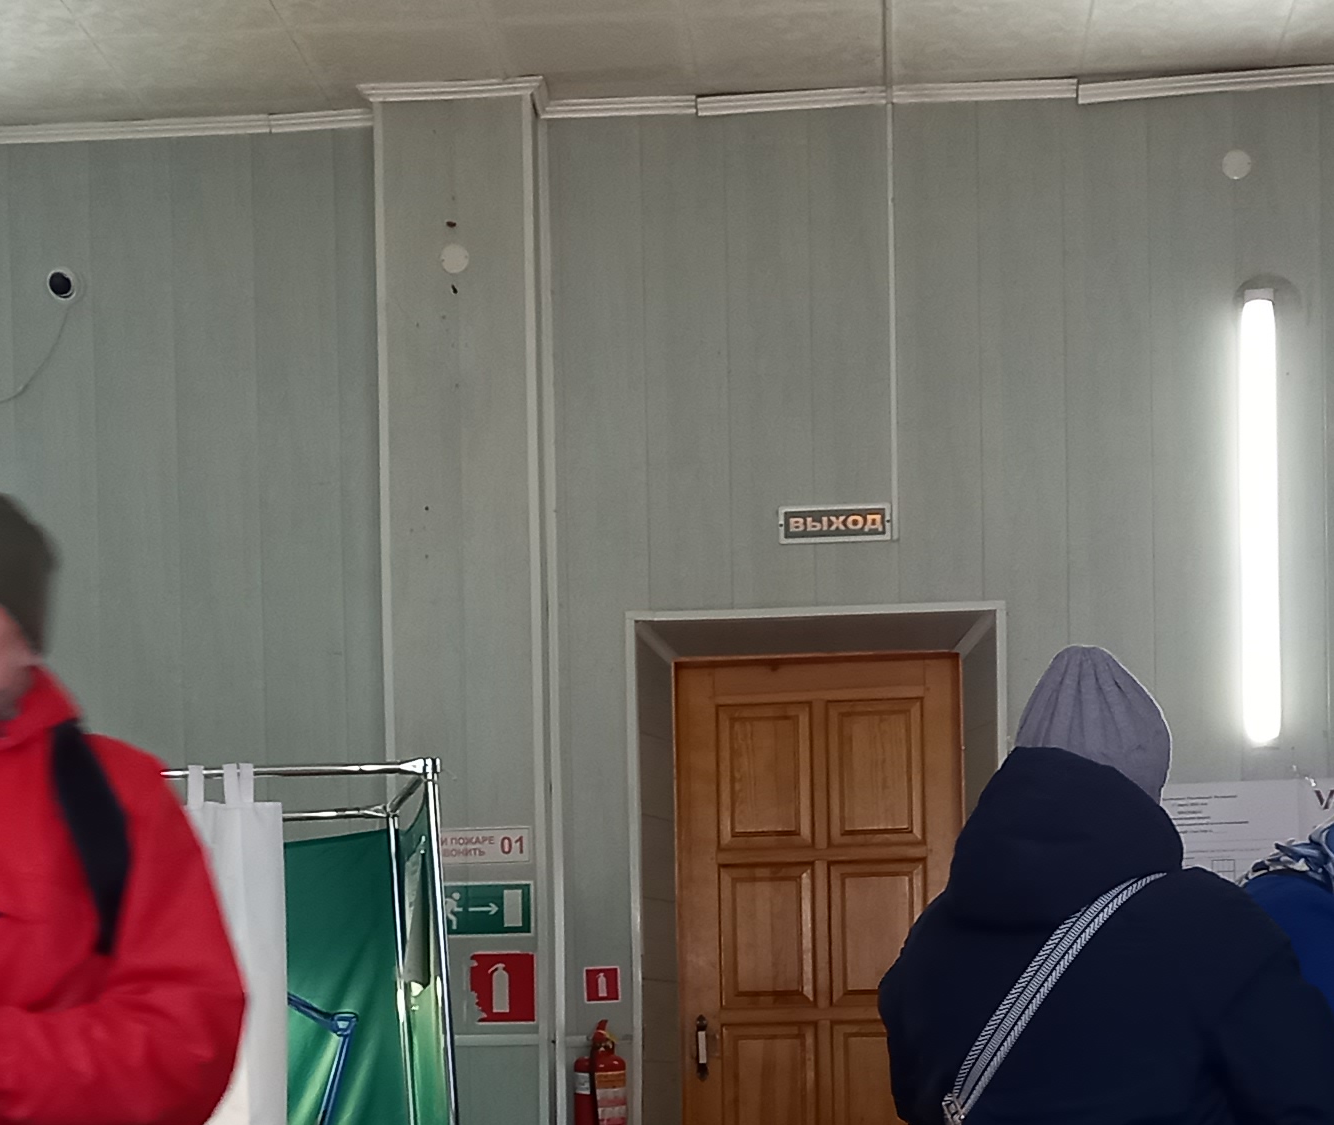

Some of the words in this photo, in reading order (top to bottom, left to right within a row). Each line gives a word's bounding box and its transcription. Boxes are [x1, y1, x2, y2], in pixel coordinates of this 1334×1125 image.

[789, 514, 883, 532] ВЫХОД
[441, 848, 486, 857] ВОНИТЬ
[451, 836, 495, 845] ПОЖАРЕ
[500, 835, 524, 855] 01
